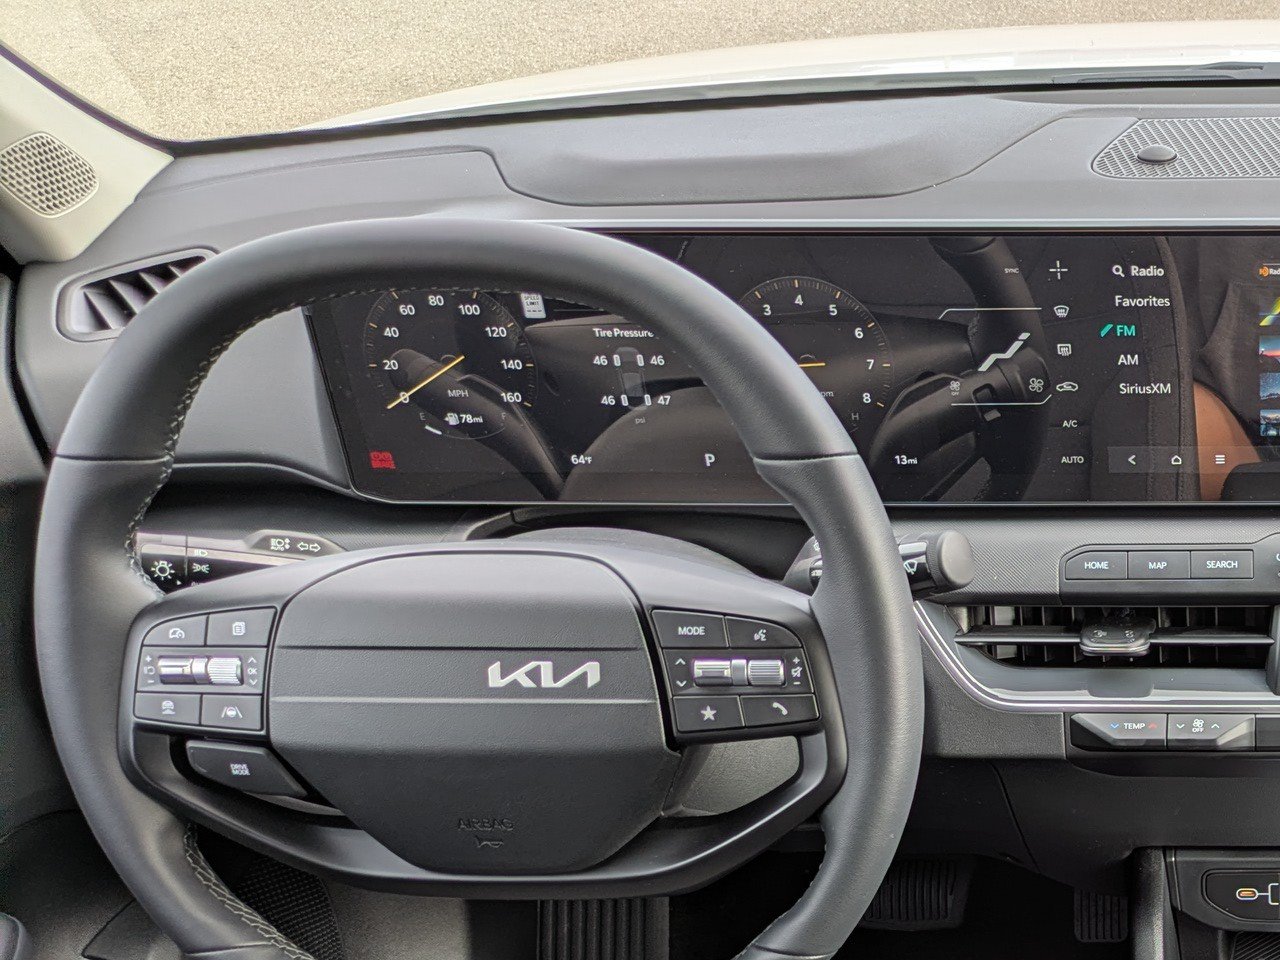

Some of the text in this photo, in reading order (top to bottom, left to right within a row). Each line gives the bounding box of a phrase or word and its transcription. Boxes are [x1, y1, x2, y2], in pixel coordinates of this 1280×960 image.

[1131, 266, 1164, 277] Radio
[428, 296, 444, 306] 80
[795, 295, 804, 306] 4
[1115, 296, 1171, 307] Favorites
[400, 305, 415, 316] 60
[459, 305, 480, 316] 100
[763, 305, 772, 316] 3
[829, 305, 838, 316] 5
[384, 327, 399, 338] 40
[485, 327, 507, 338] 120
[593, 328, 654, 338] Tire Pressure
[855, 328, 864, 338] 6
[1116, 325, 1136, 336] FM
[383, 360, 399, 370] 20
[501, 360, 522, 370] 140
[593, 356, 608, 366] 46
[650, 355, 665, 366] 46
[866, 360, 874, 370] 7
[1118, 355, 1139, 366] AM
[448, 390, 469, 398] MPH
[1119, 383, 1172, 394] SiriusXM
[400, 392, 410, 404] 0
[501, 392, 522, 403] 160
[601, 395, 616, 406] 46
[658, 395, 671, 405] 47
[863, 392, 871, 404] 8
[635, 417, 646, 425] psi
[1062, 420, 1078, 428] A/C
[704, 454, 716, 467] P
[1061, 456, 1084, 464] AUTO
[1084, 562, 1109, 570] HOME
[1148, 562, 1168, 570] MAP
[1206, 560, 1238, 569] SEARCH
[678, 626, 706, 636] MODE
[487, 660, 601, 688] KIA
[1124, 722, 1146, 730] TEMP
